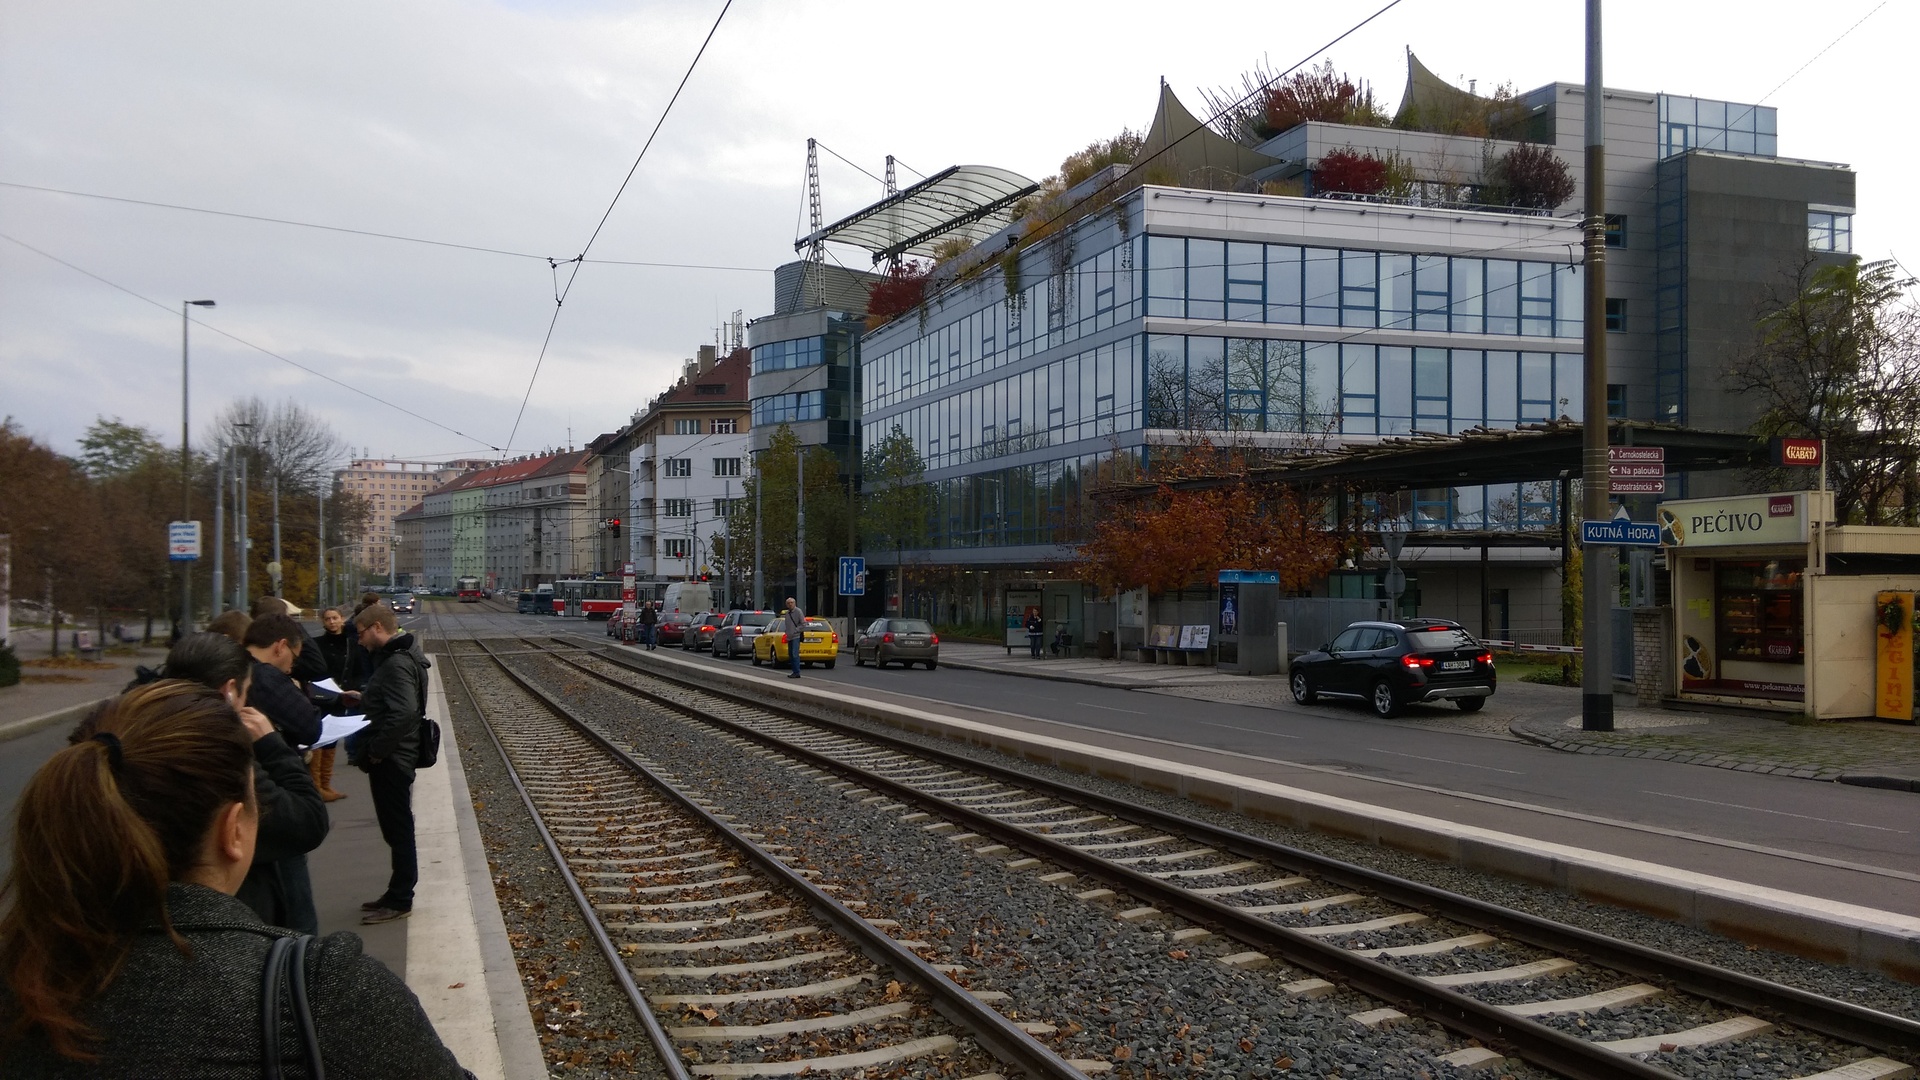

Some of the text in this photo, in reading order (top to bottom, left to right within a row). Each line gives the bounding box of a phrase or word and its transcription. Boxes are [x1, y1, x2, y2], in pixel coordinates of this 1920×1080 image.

[1618, 449, 1659, 459] Černokostelecká
[1621, 466, 1660, 476] Na palouku
[1612, 482, 1653, 491] Starostrašnická
[1691, 509, 1763, 534] PEČIVO
[1588, 524, 1656, 540] KUTNÁ HORA
